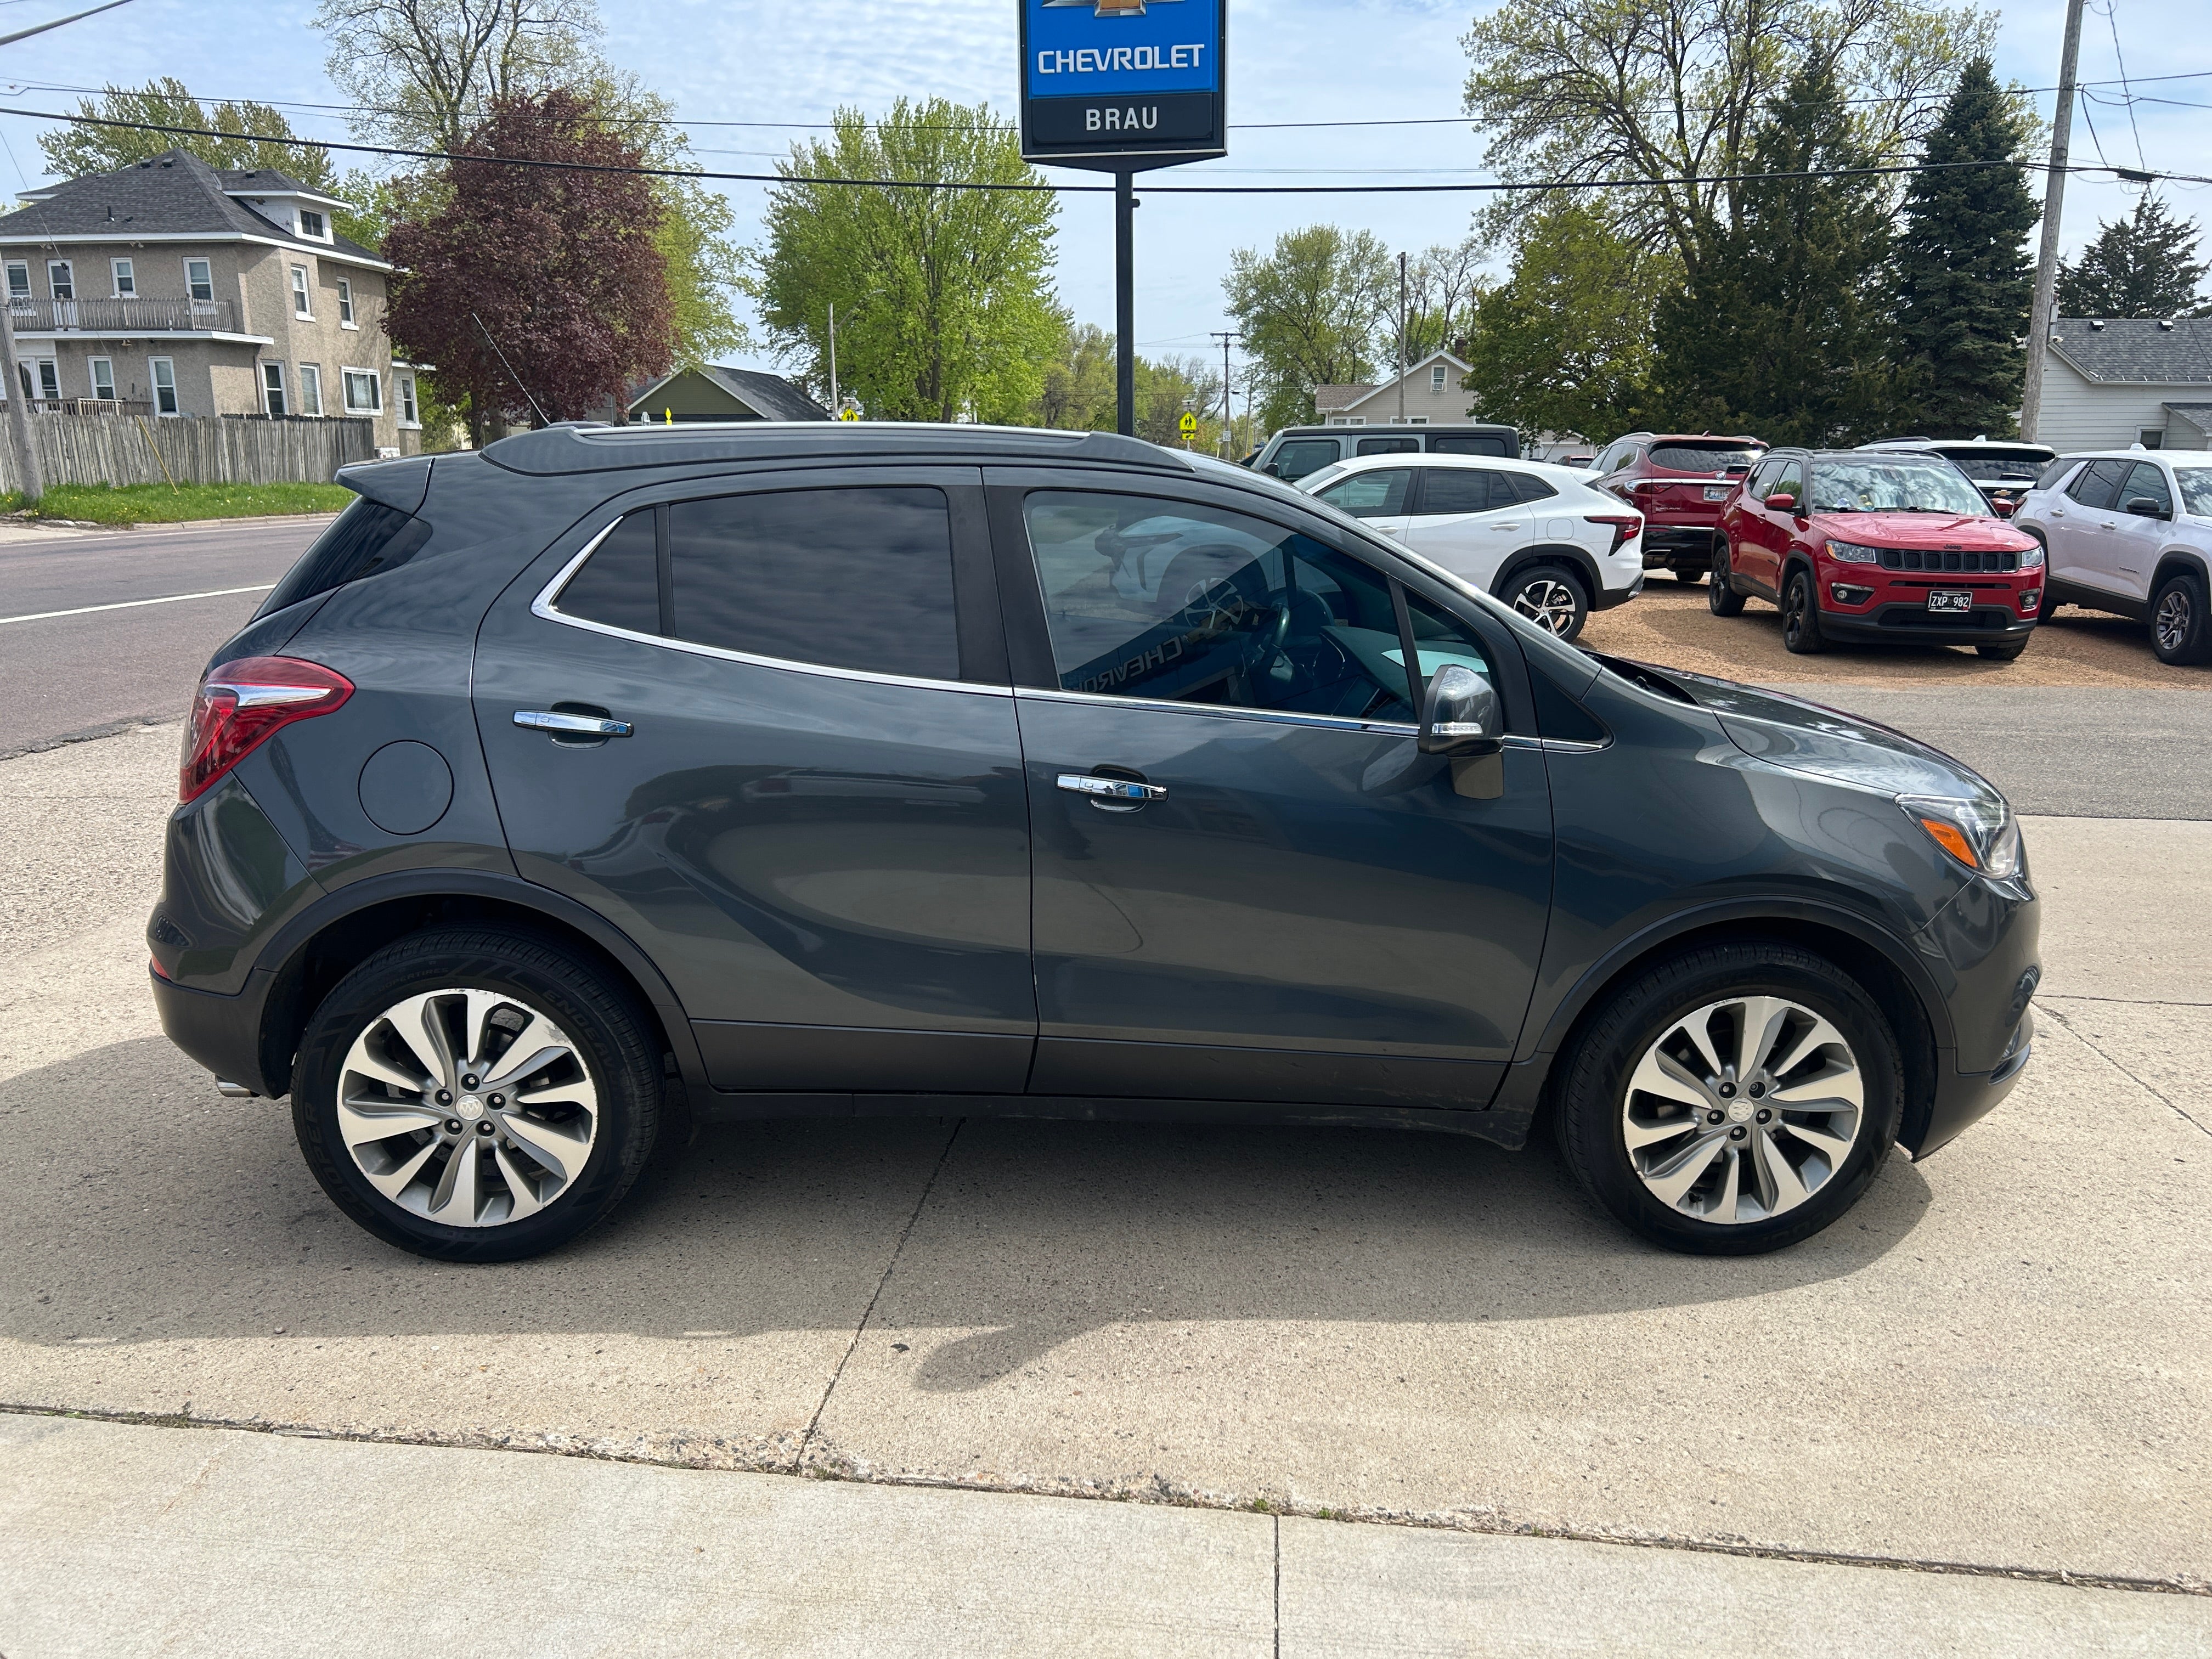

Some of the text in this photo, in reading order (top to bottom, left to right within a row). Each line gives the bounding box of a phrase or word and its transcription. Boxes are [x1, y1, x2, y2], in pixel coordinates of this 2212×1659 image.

[1038, 43, 1205, 74] CHEVROLET
[1085, 106, 1158, 131] BRAU
[1931, 596, 1970, 607] ZXP 982
[304, 1102, 375, 1218] COOPER
